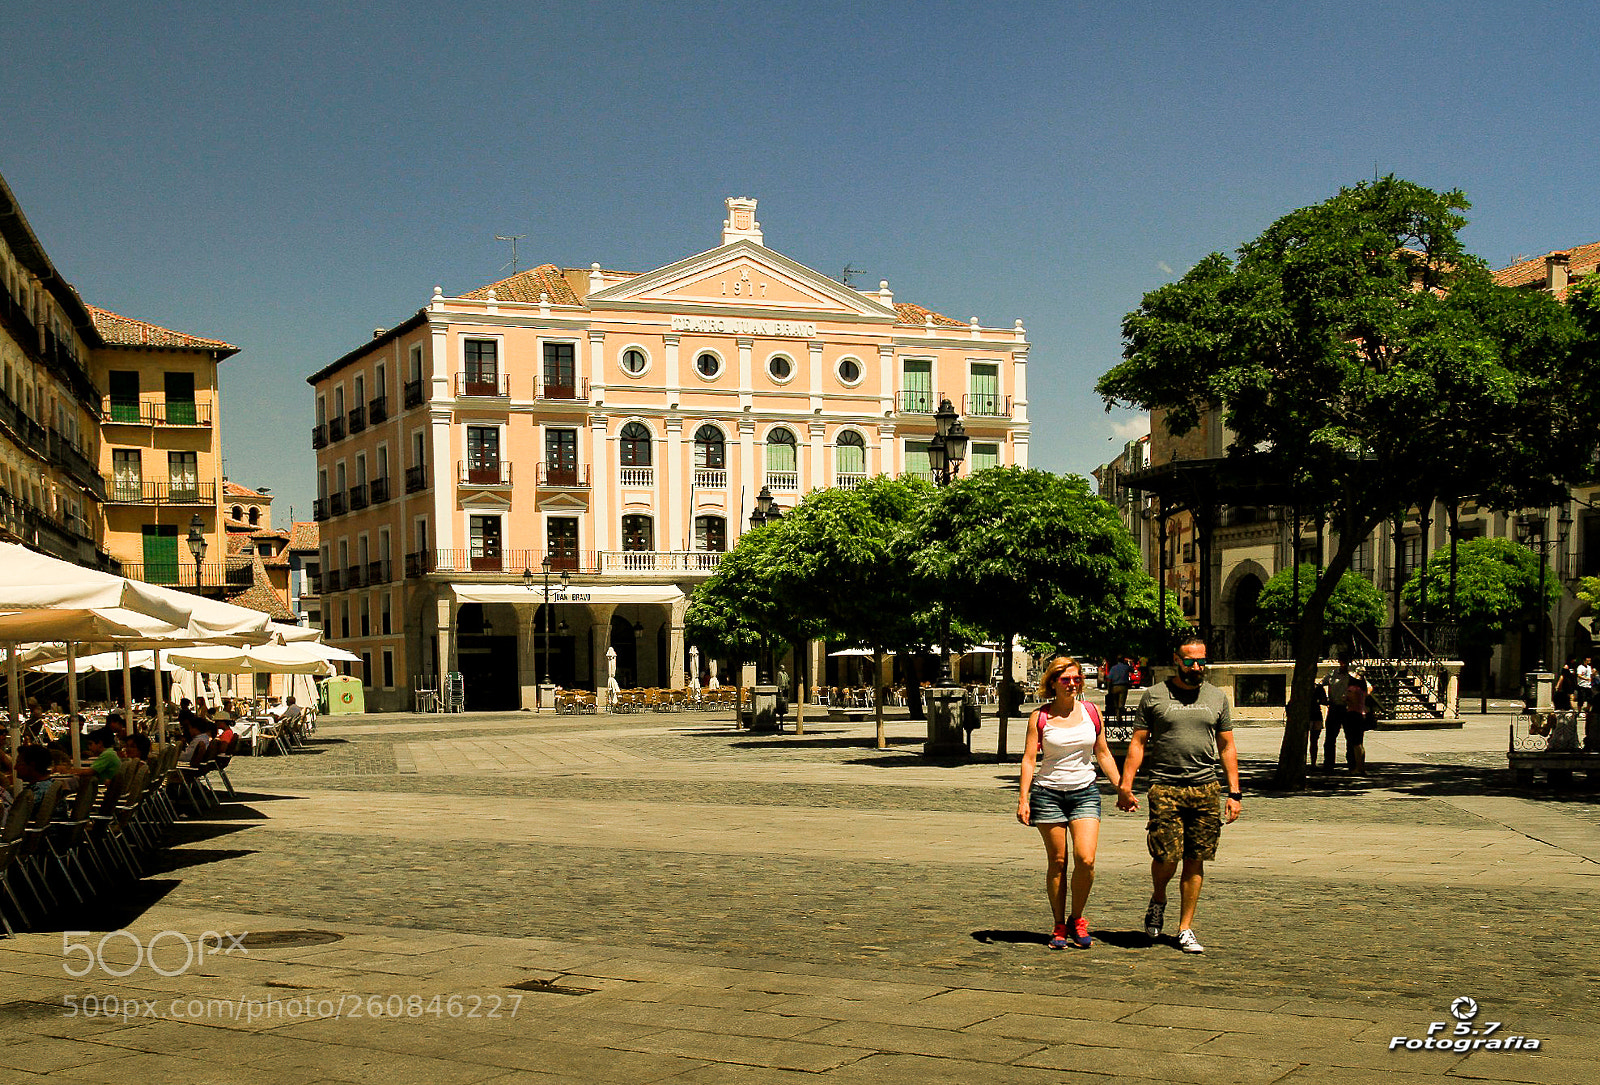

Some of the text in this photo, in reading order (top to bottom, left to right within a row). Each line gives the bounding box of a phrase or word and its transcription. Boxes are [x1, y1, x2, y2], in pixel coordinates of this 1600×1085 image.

[721, 281, 768, 298] 1917
[673, 317, 815, 338] TEATRO JUAN BRAVO
[553, 592, 591, 603] JUAN BRAVO
